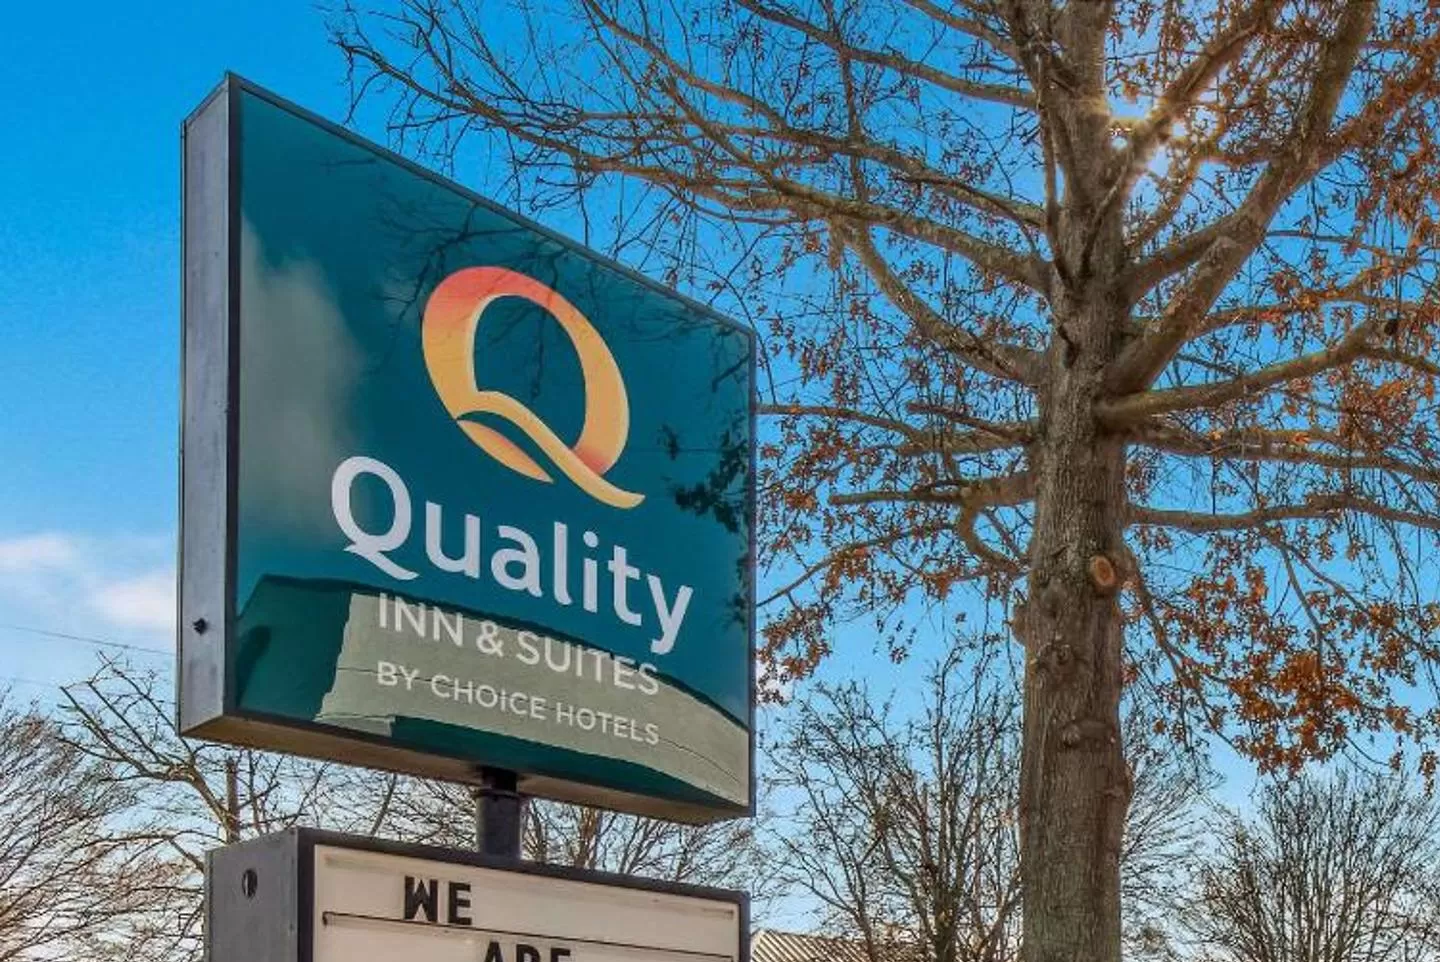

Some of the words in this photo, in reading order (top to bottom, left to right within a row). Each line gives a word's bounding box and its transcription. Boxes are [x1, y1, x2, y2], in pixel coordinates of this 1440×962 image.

[331, 456, 695, 655] Quality
[379, 592, 464, 649] INN
[476, 619, 504, 658] &
[516, 635, 660, 696] SUITES
[376, 661, 420, 692] BY
[431, 673, 546, 722] CHOICE
[556, 703, 660, 746] HOTELS
[403, 875, 473, 926] WE
